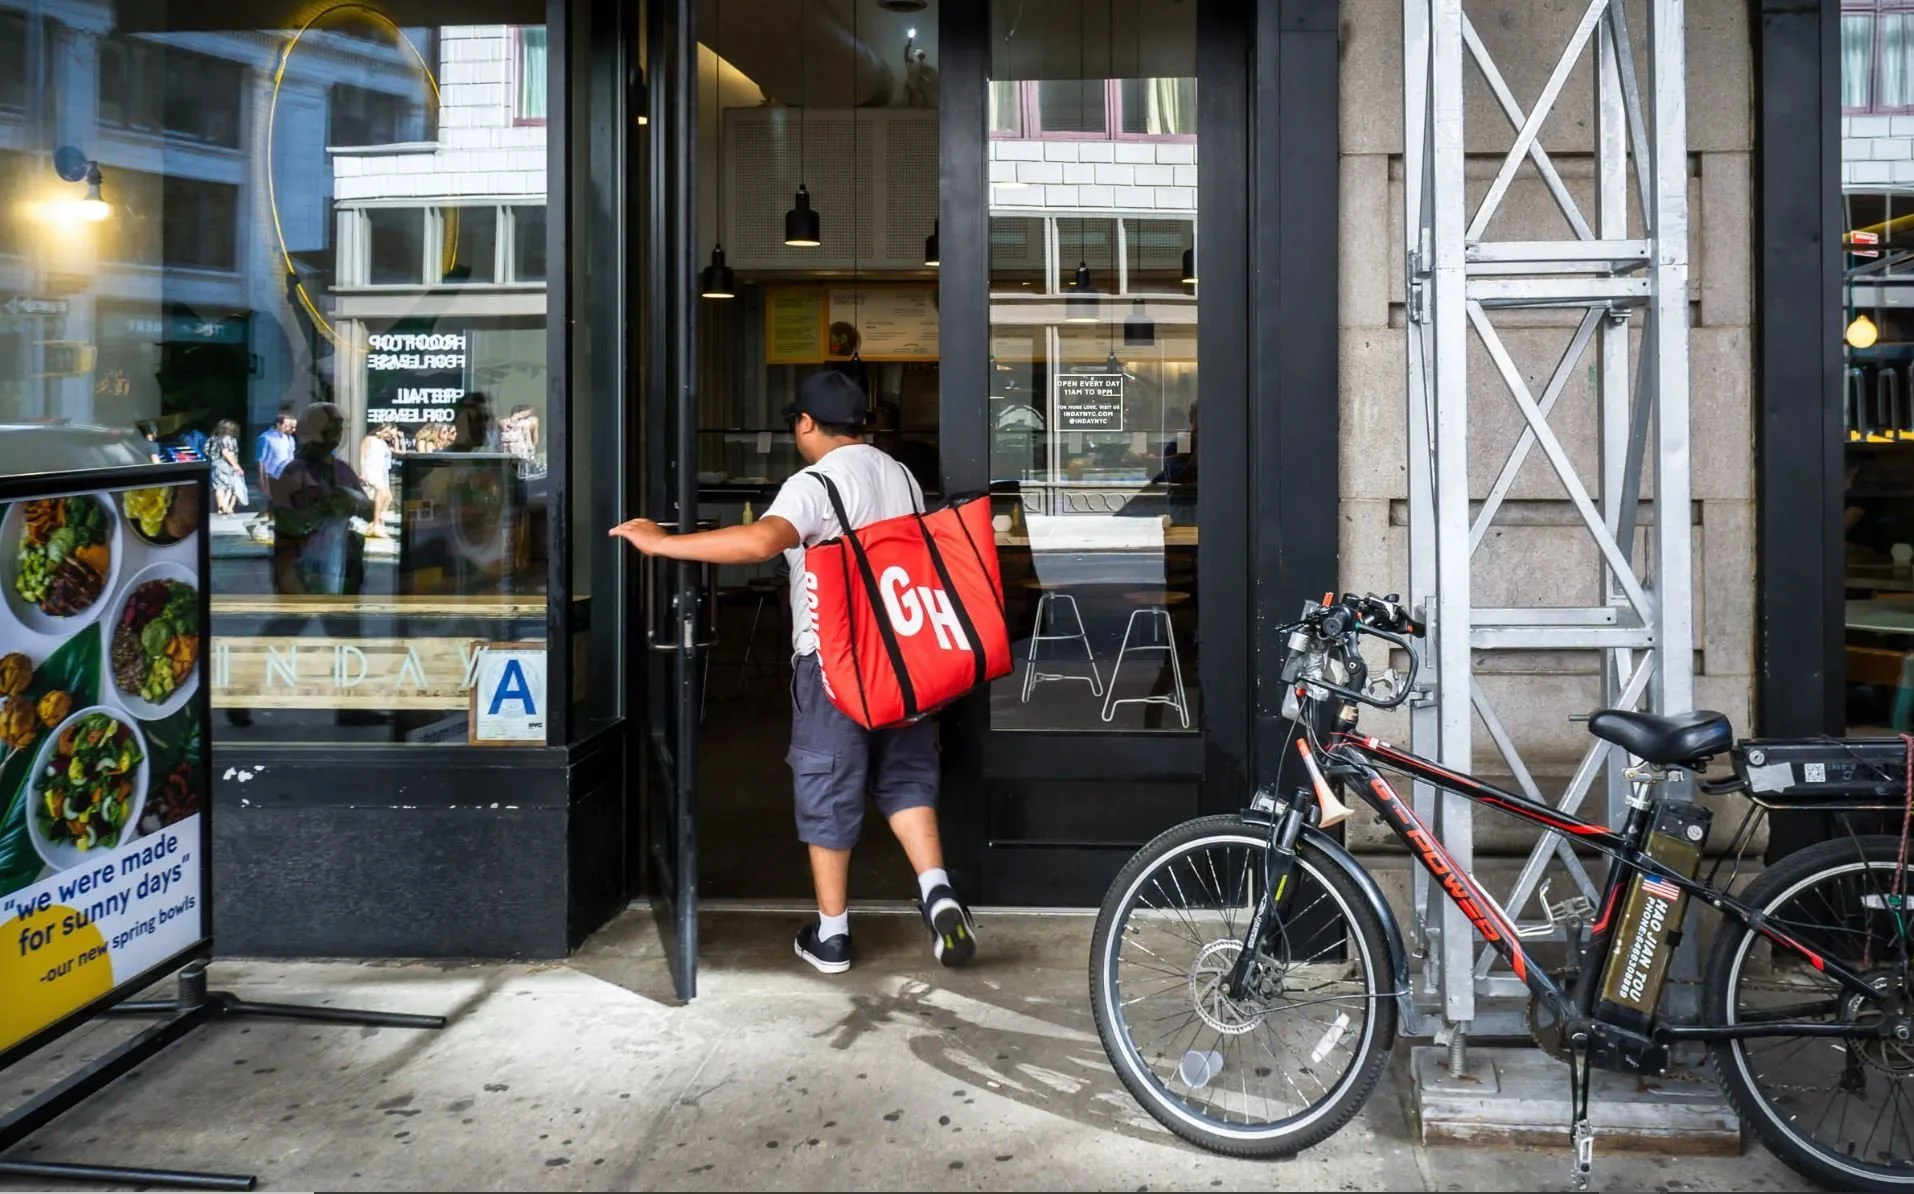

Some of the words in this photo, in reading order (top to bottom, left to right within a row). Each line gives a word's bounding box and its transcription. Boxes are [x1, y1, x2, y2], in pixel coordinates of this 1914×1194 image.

[880, 565, 972, 651] GH
[215, 645, 488, 688] INDAY
[487, 659, 537, 715] A
[59, 864, 115, 903] were
[121, 833, 178, 875] made
[19, 923, 55, 956] for
[62, 888, 131, 936] sunny
[40, 958, 74, 983] -our
[78, 941, 109, 966] new
[112, 917, 156, 949] spring
[159, 895, 196, 925] bowls
[1650, 899, 1668, 932] HAO
[1639, 931, 1658, 969] JIAN
[1629, 970, 1647, 1003] TOU
